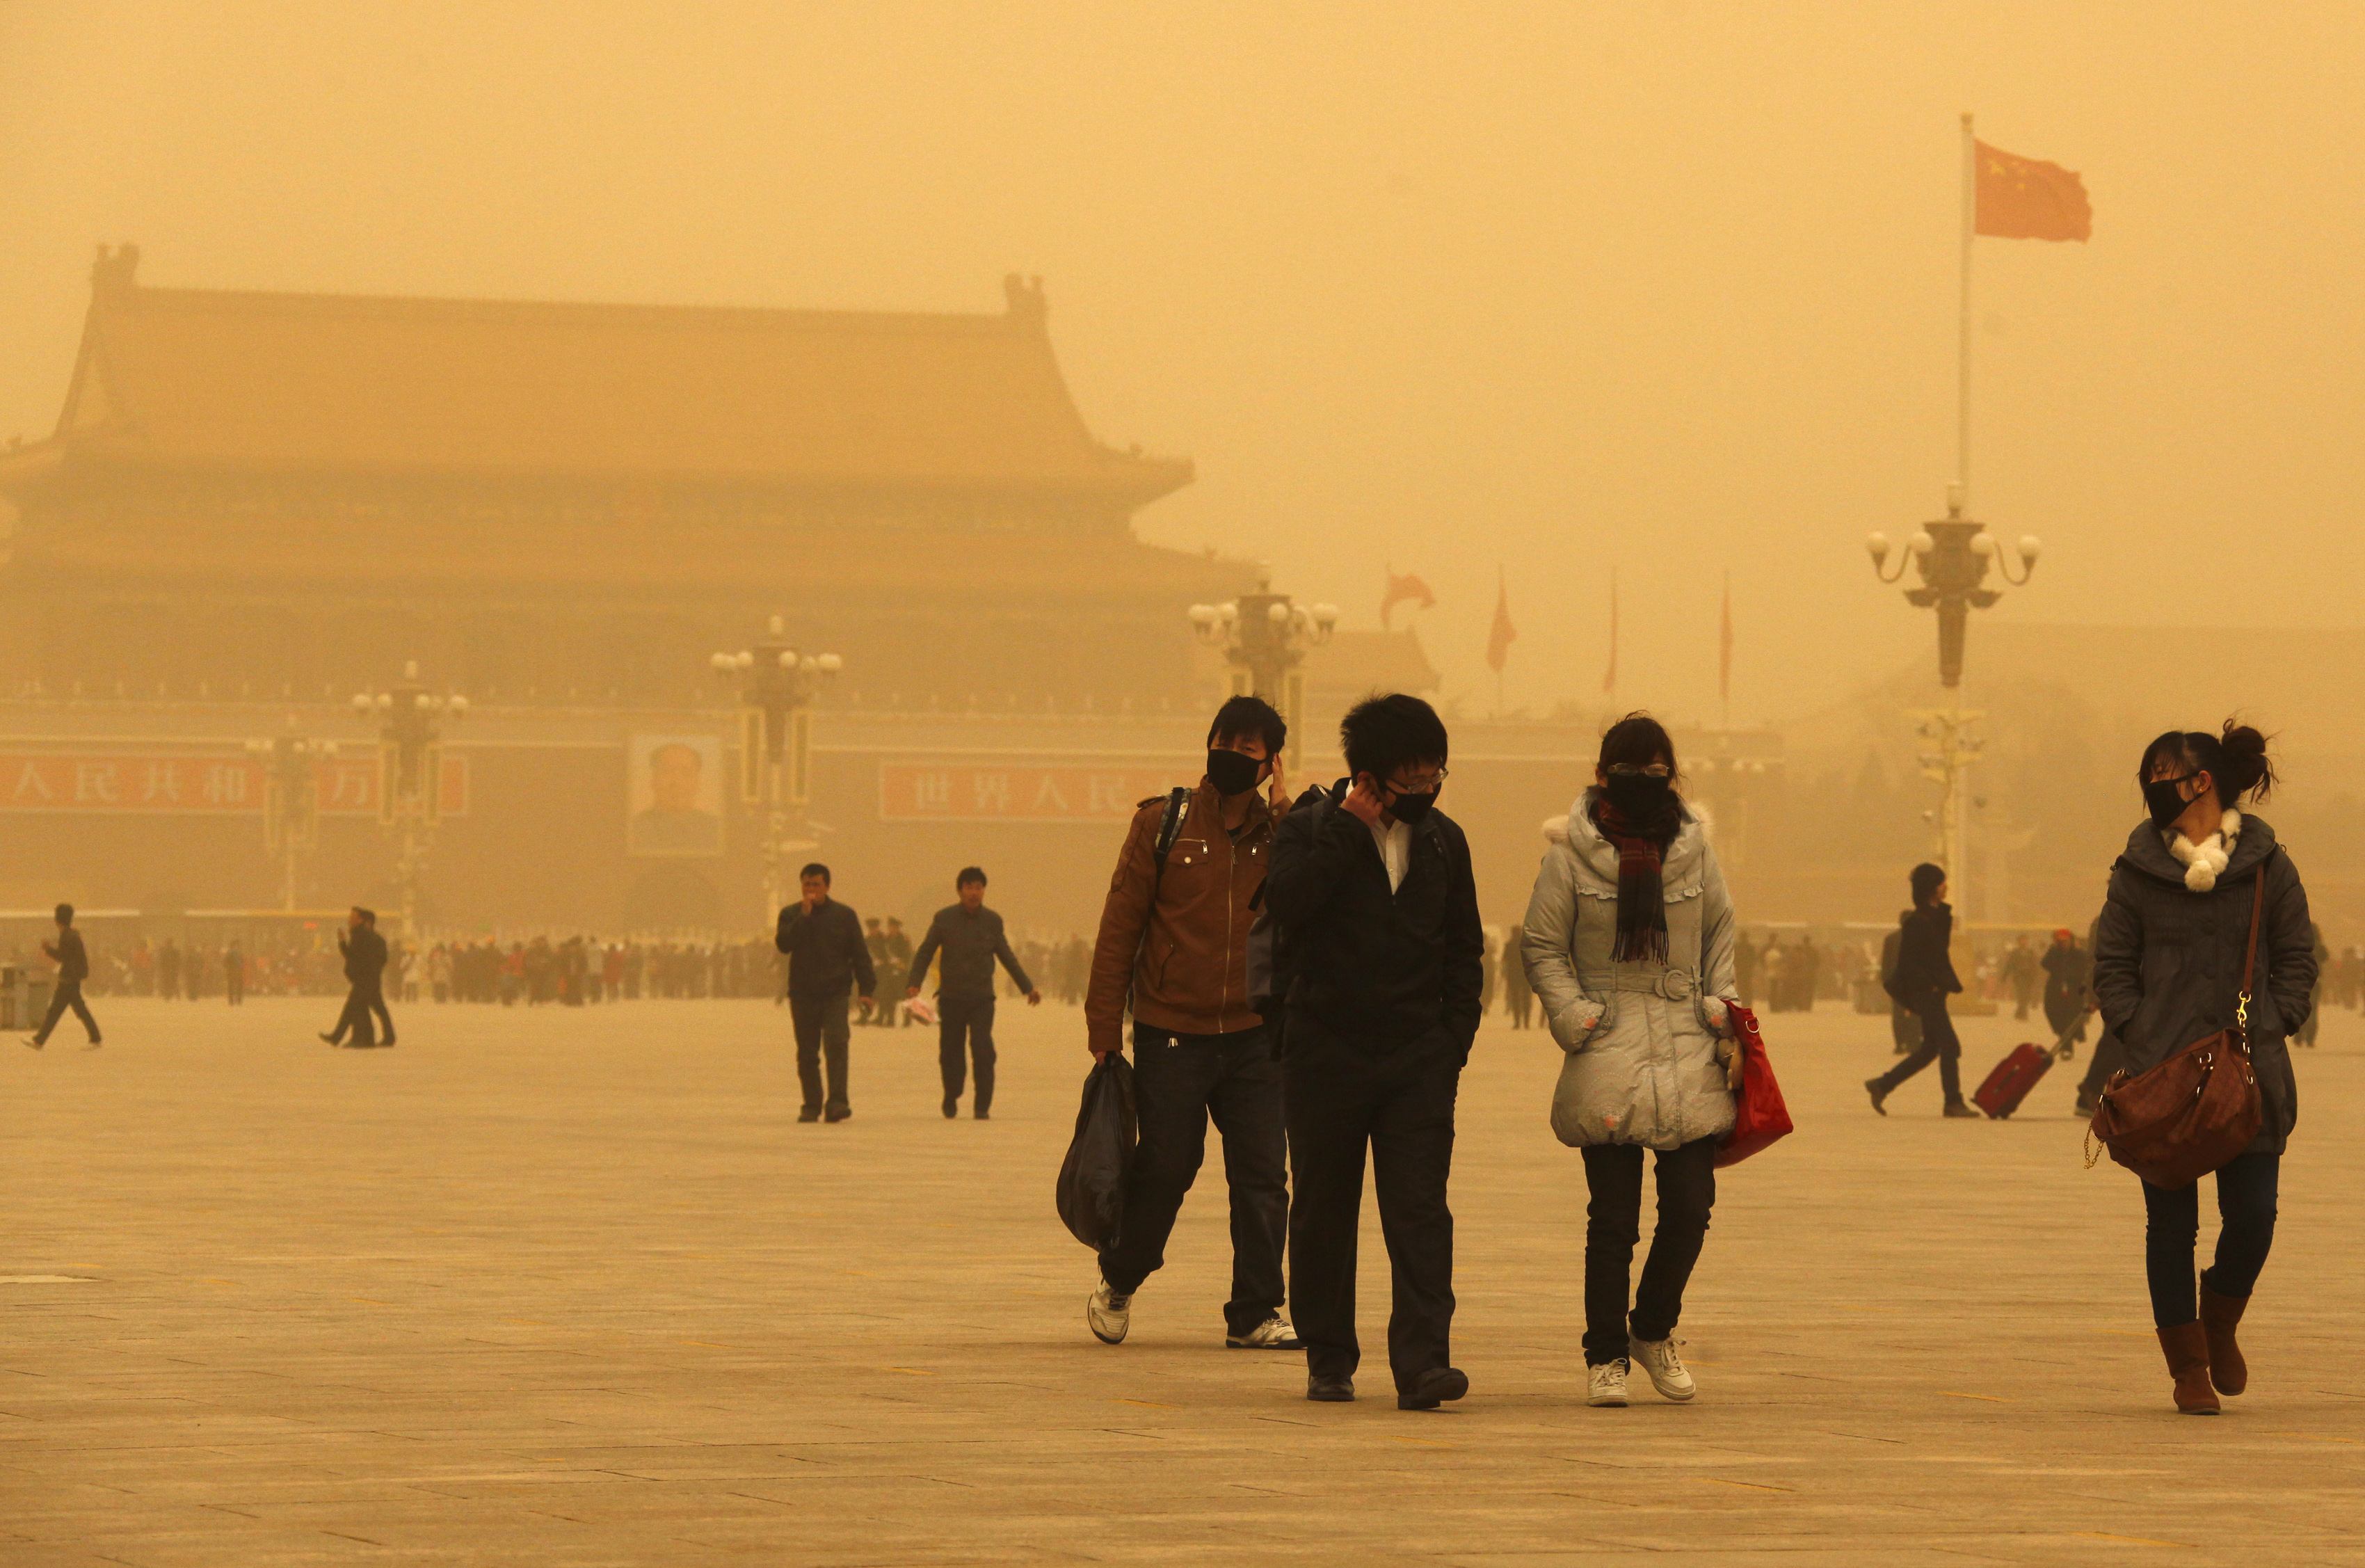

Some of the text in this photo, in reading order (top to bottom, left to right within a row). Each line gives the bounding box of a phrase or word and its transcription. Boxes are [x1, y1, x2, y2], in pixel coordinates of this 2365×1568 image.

[13, 762, 423, 804] 人民共和万
